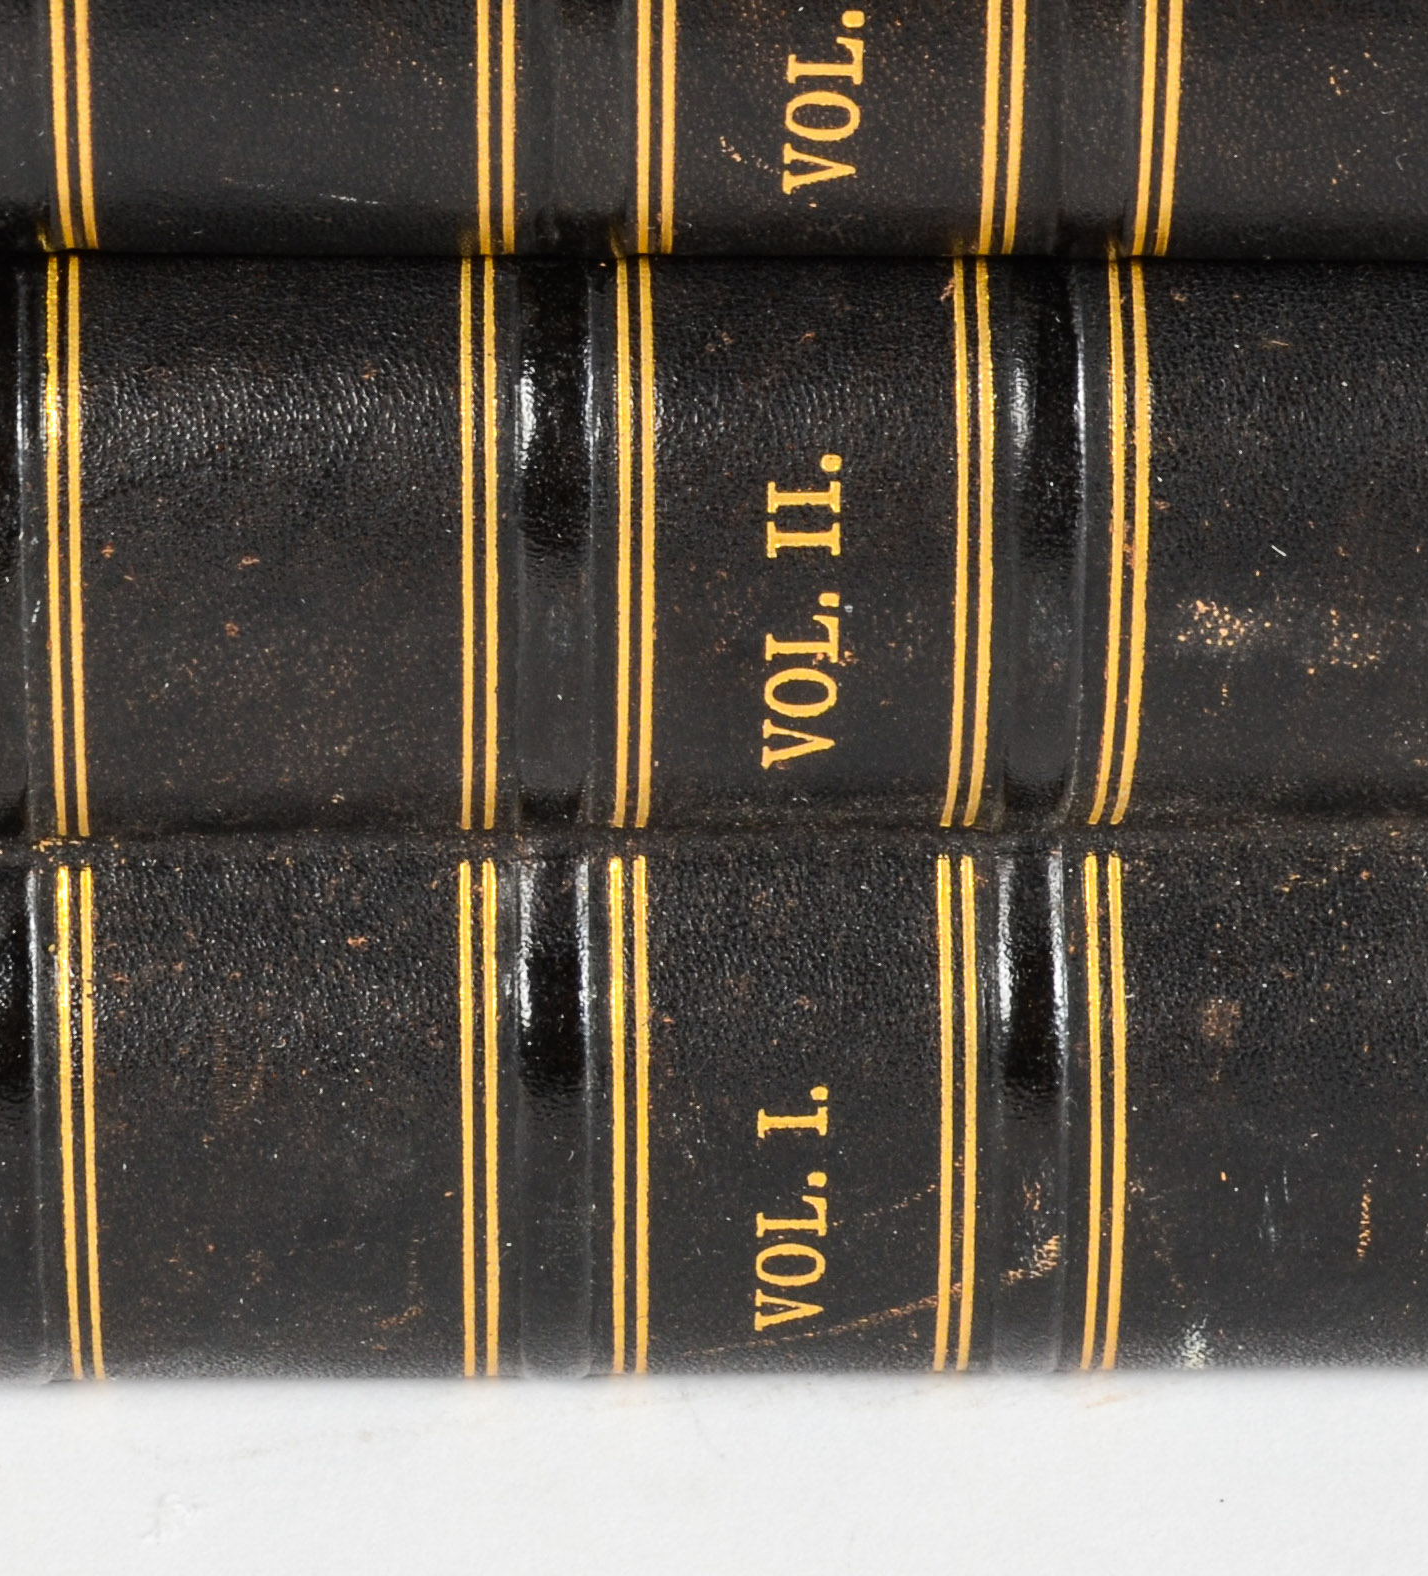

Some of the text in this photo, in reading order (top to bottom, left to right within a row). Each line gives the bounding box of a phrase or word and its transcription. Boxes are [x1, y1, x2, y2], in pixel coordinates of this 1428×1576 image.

[781, 9, 865, 196] VOL.
[761, 452, 843, 770] VOL. II.
[754, 1084, 830, 1332] VOL. I.
